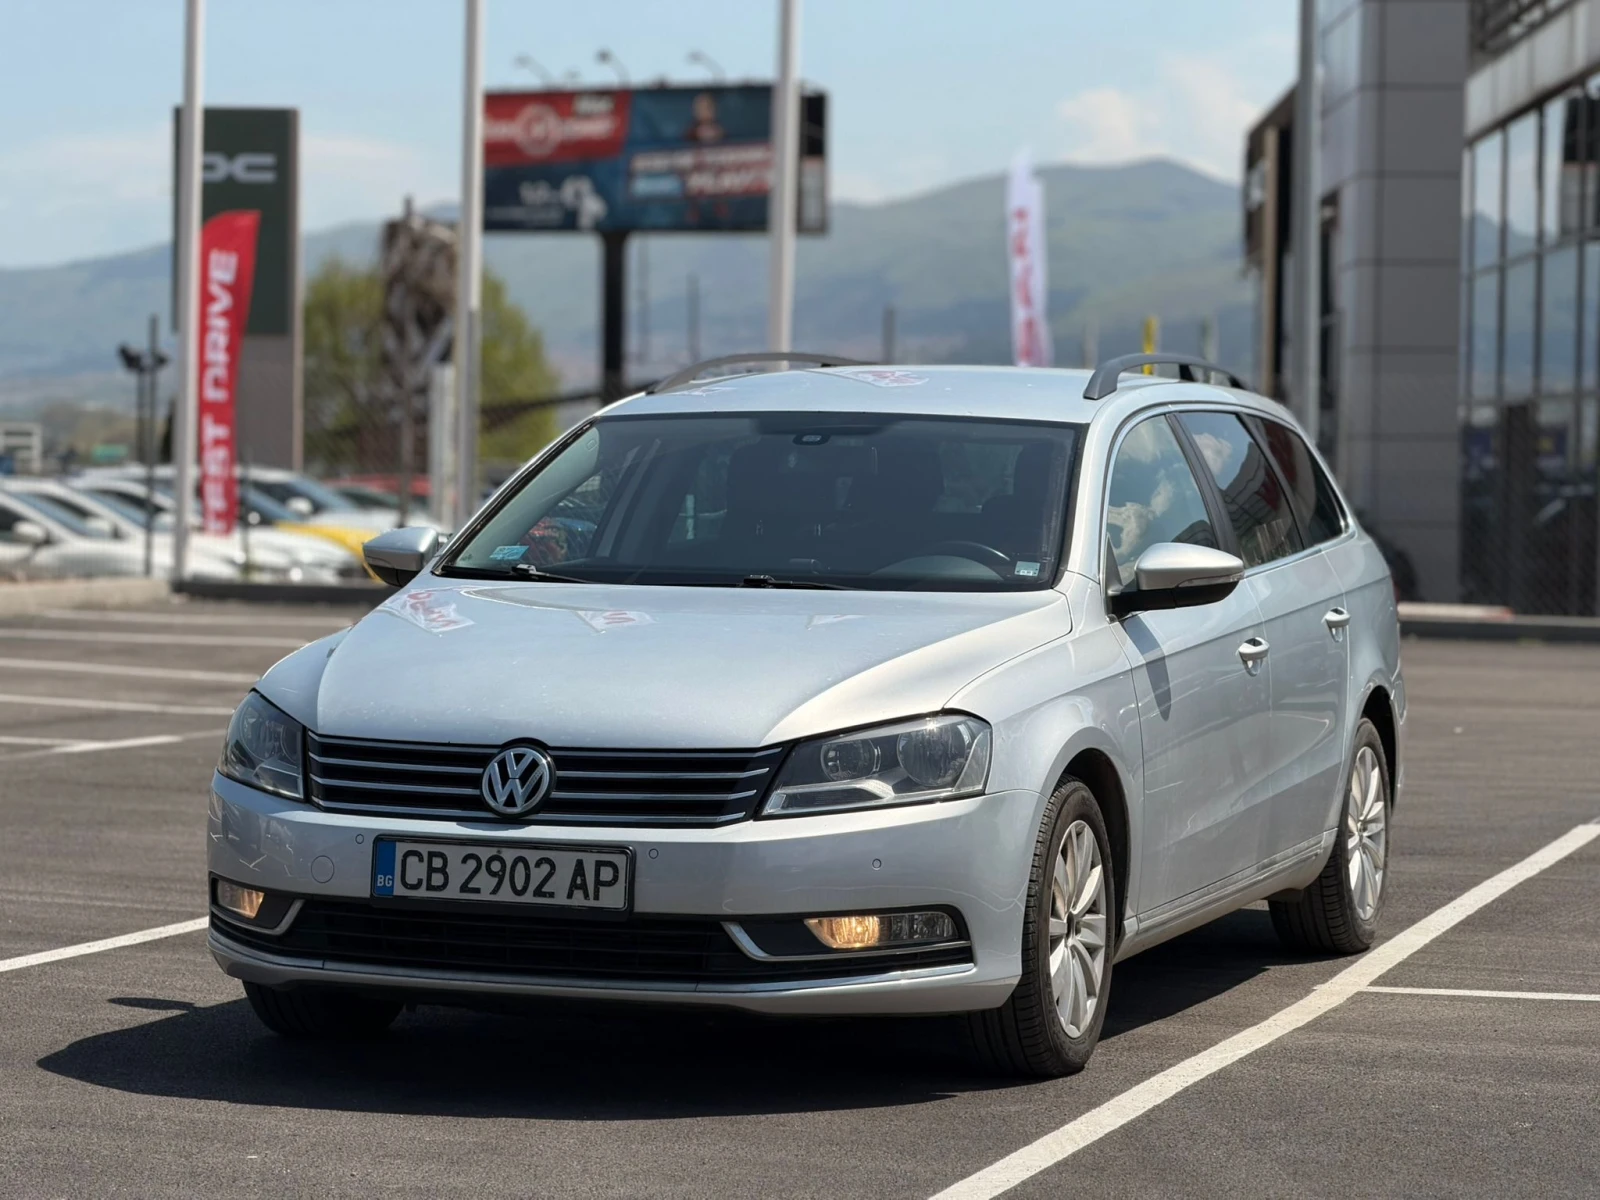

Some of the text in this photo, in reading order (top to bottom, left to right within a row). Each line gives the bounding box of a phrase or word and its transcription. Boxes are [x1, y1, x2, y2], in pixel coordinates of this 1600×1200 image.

[202, 249, 239, 535] TEST DRIVE
[376, 873, 394, 888] BG
[400, 849, 620, 901] CB 2902 AP
